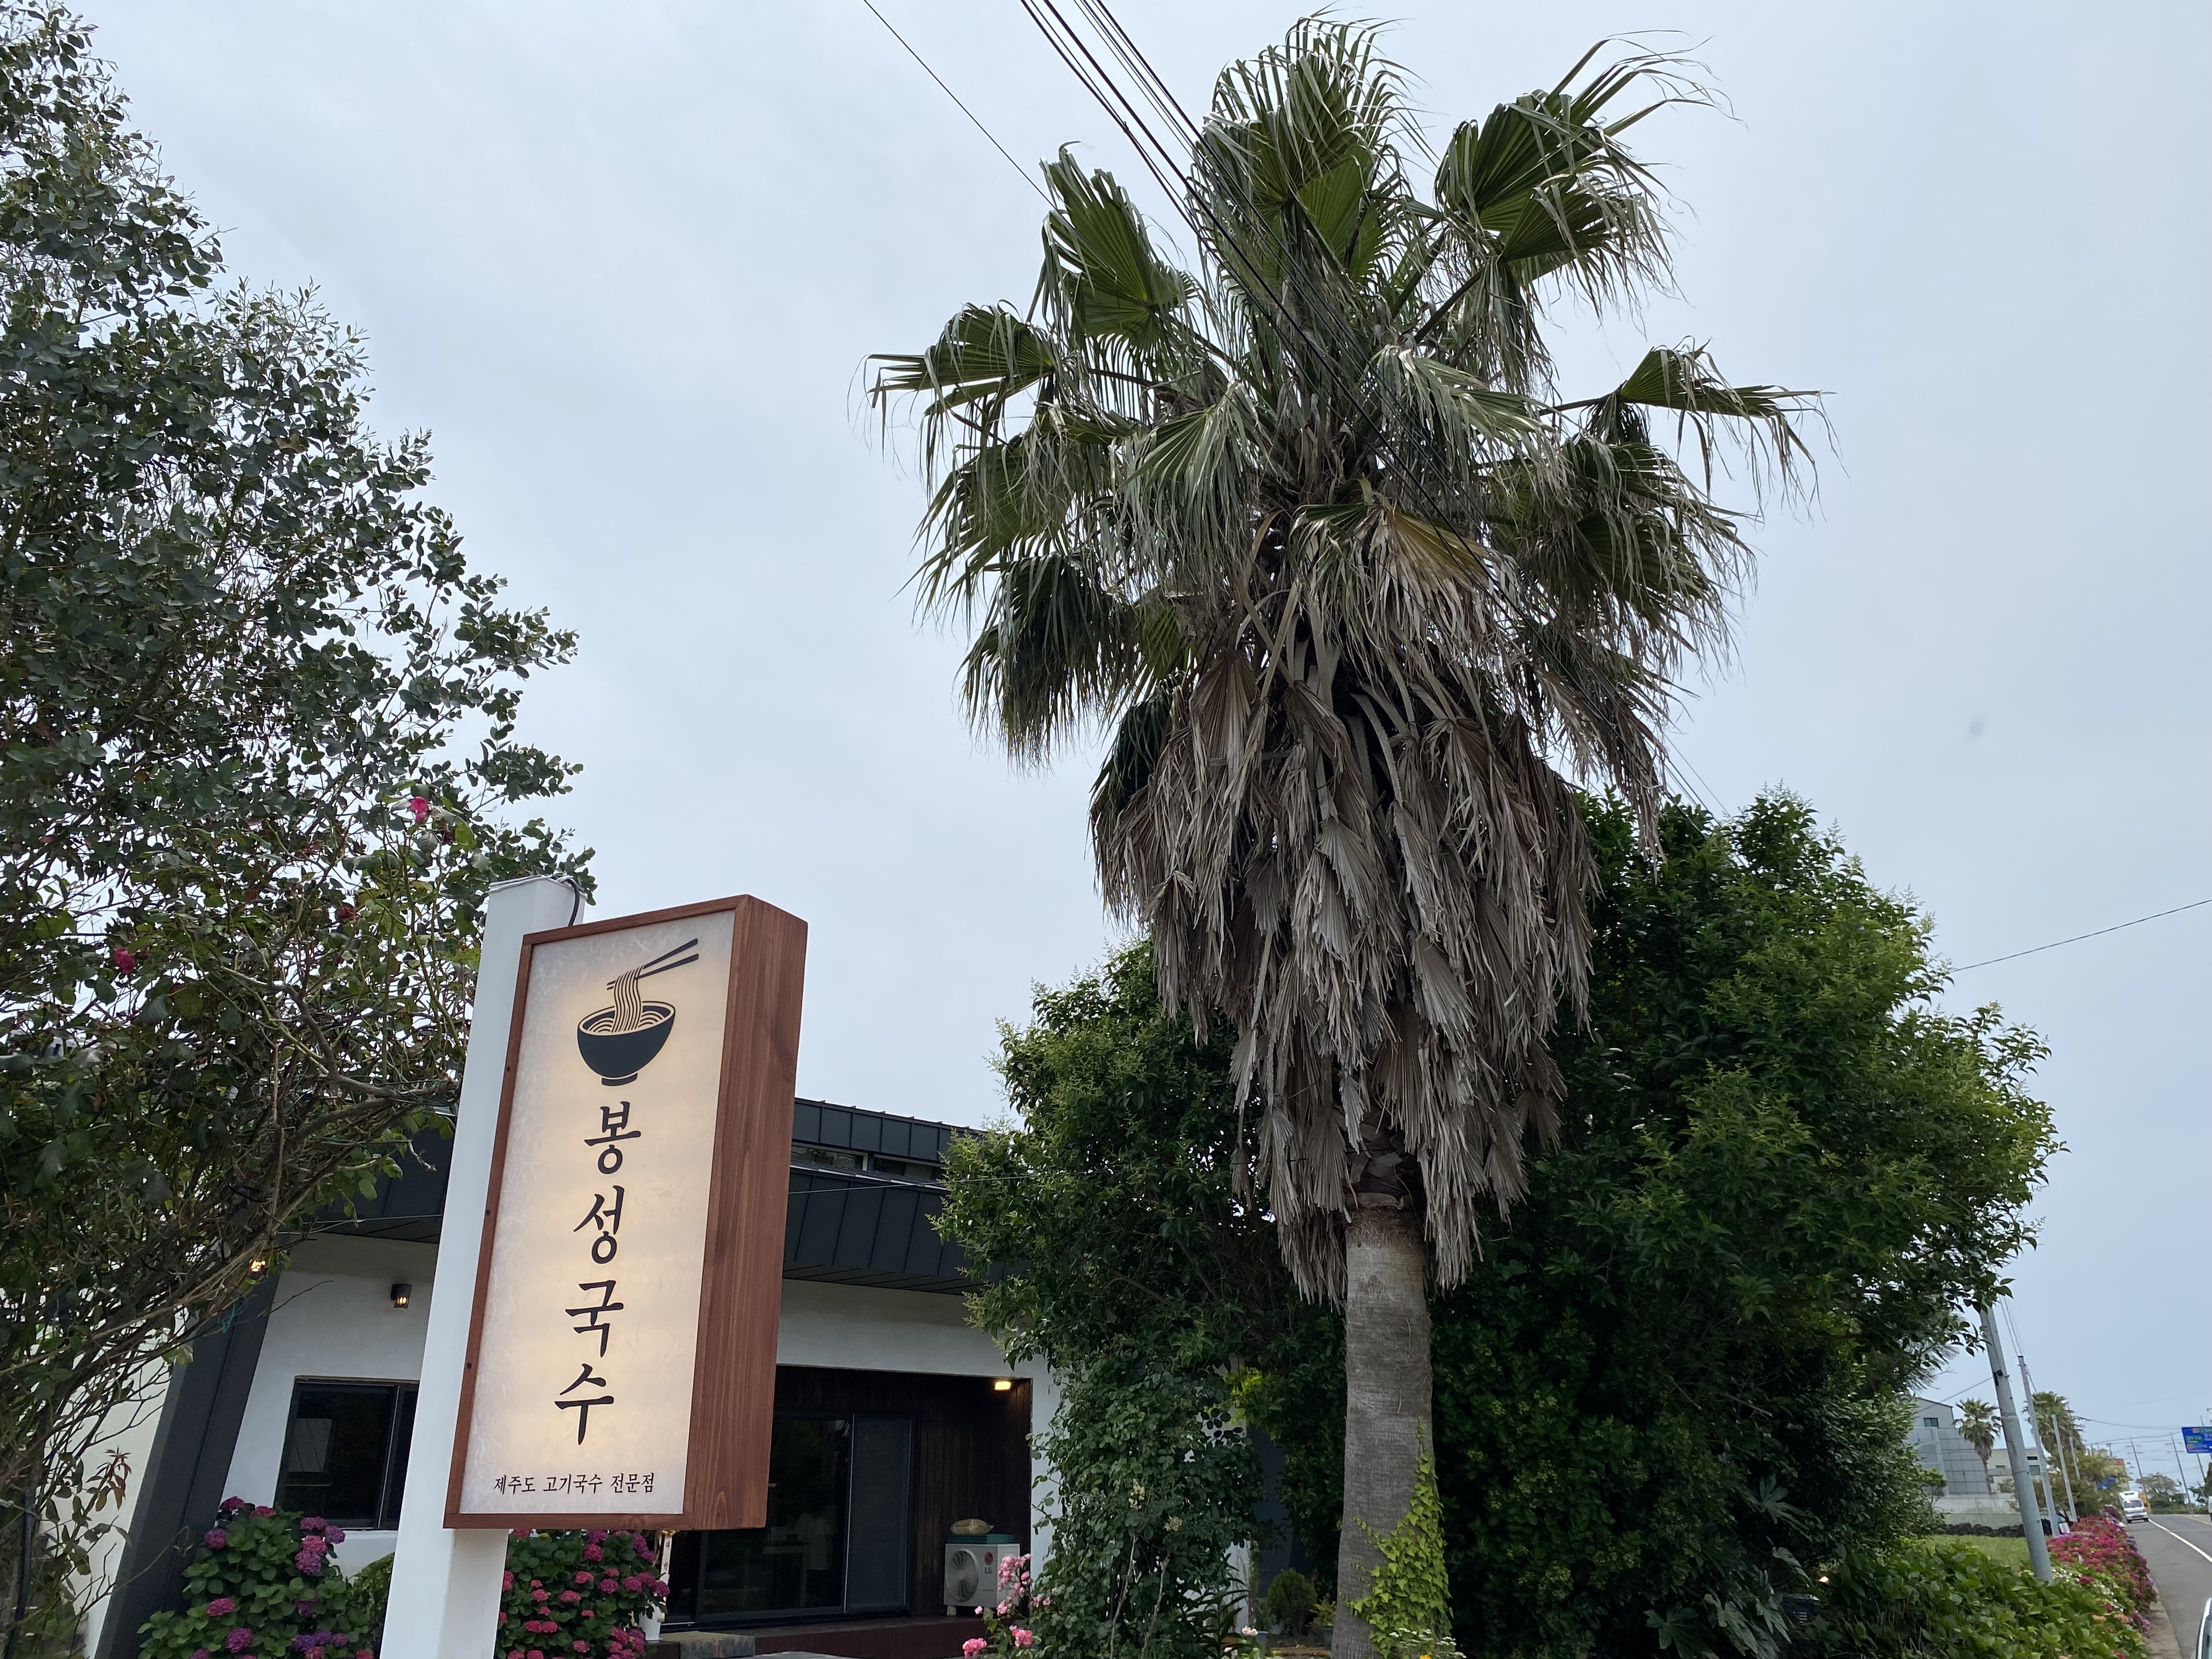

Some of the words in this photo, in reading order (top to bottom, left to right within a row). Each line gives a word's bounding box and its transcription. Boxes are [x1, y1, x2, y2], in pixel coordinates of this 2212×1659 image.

[554, 1101, 641, 1446] 봉성국수
[493, 1474, 536, 1496] 제주도
[543, 1473, 603, 1495] 고기국수
[610, 1472, 654, 1494] 전문점
